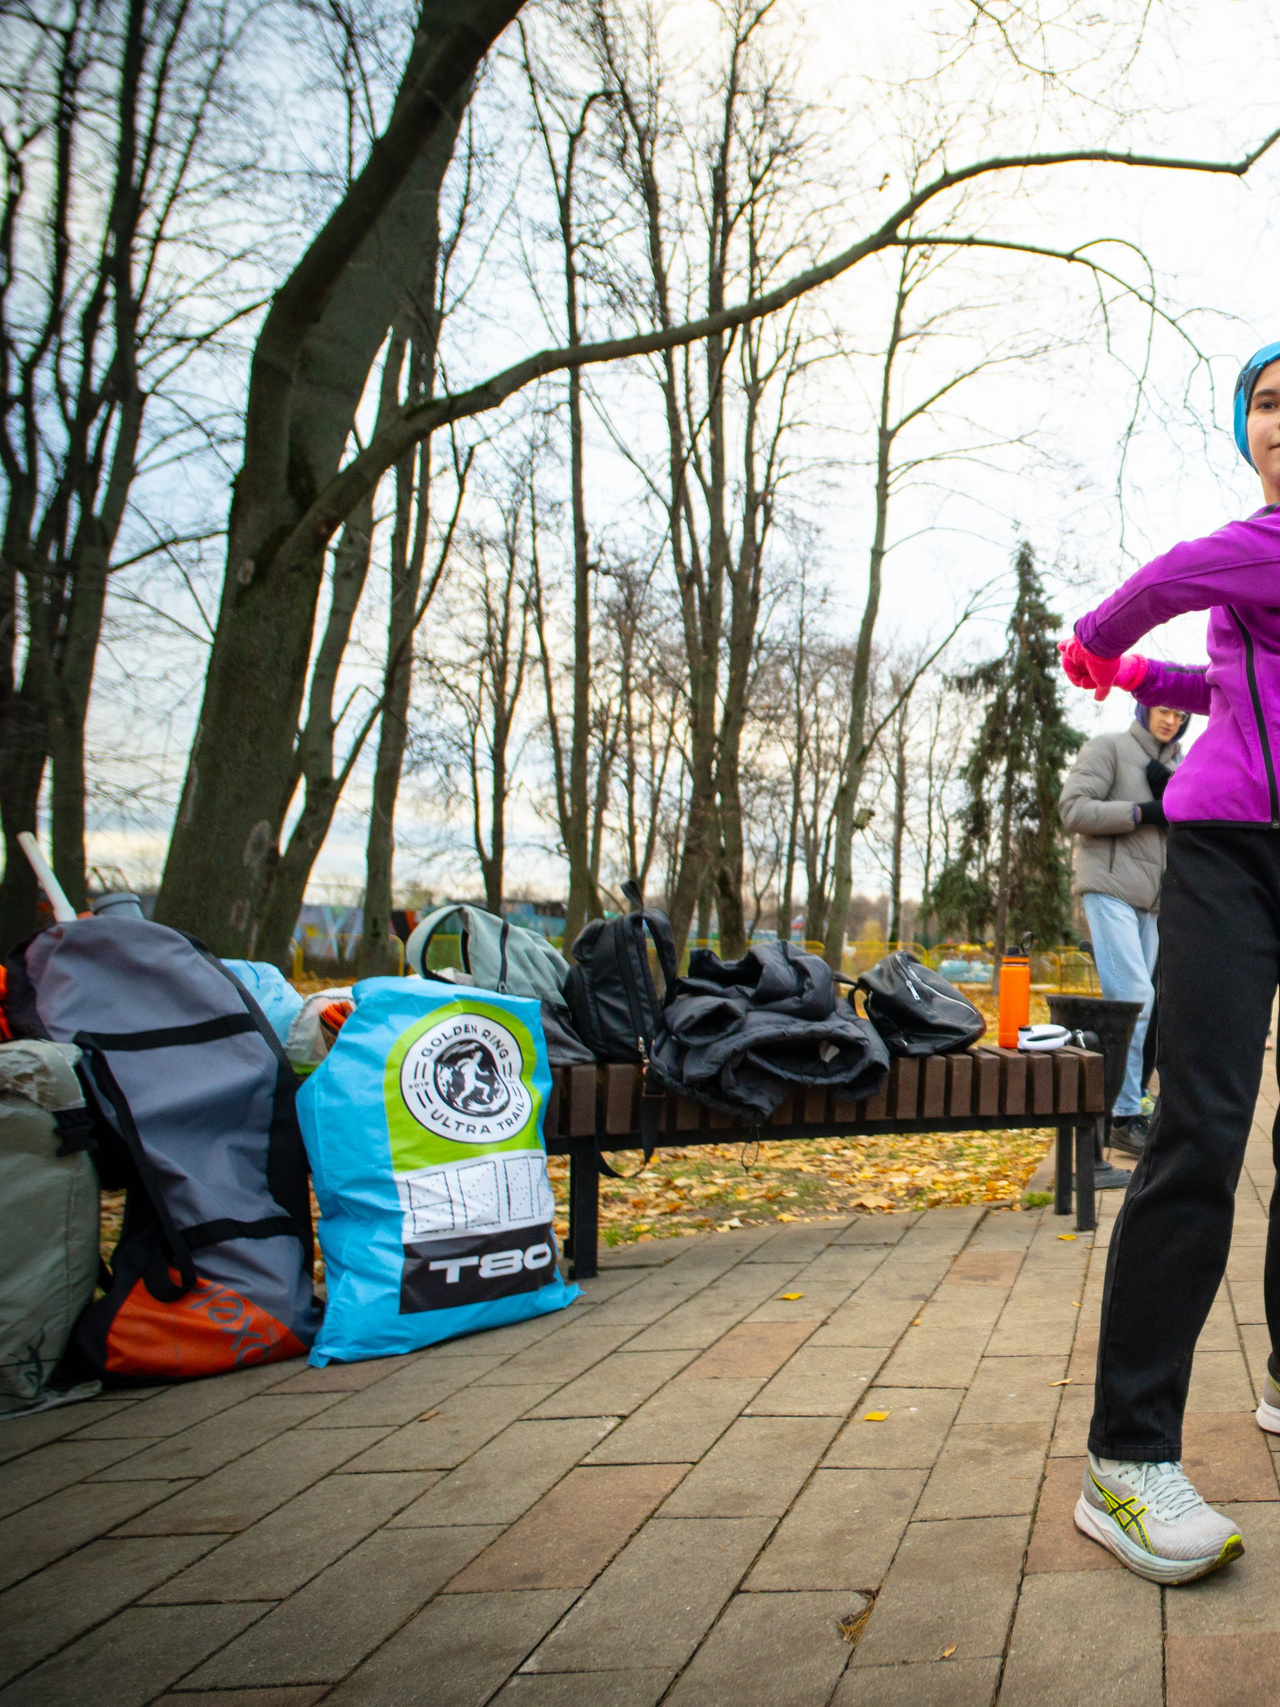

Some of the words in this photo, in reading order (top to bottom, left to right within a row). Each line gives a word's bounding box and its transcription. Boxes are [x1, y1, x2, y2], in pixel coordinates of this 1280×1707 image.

[421, 1023, 478, 1057] GOLDEN
[481, 1028, 509, 1059] RING
[430, 1109, 491, 1134] ULTRA
[496, 1102, 525, 1131] TRAIL
[428, 1242, 553, 1284] T80
